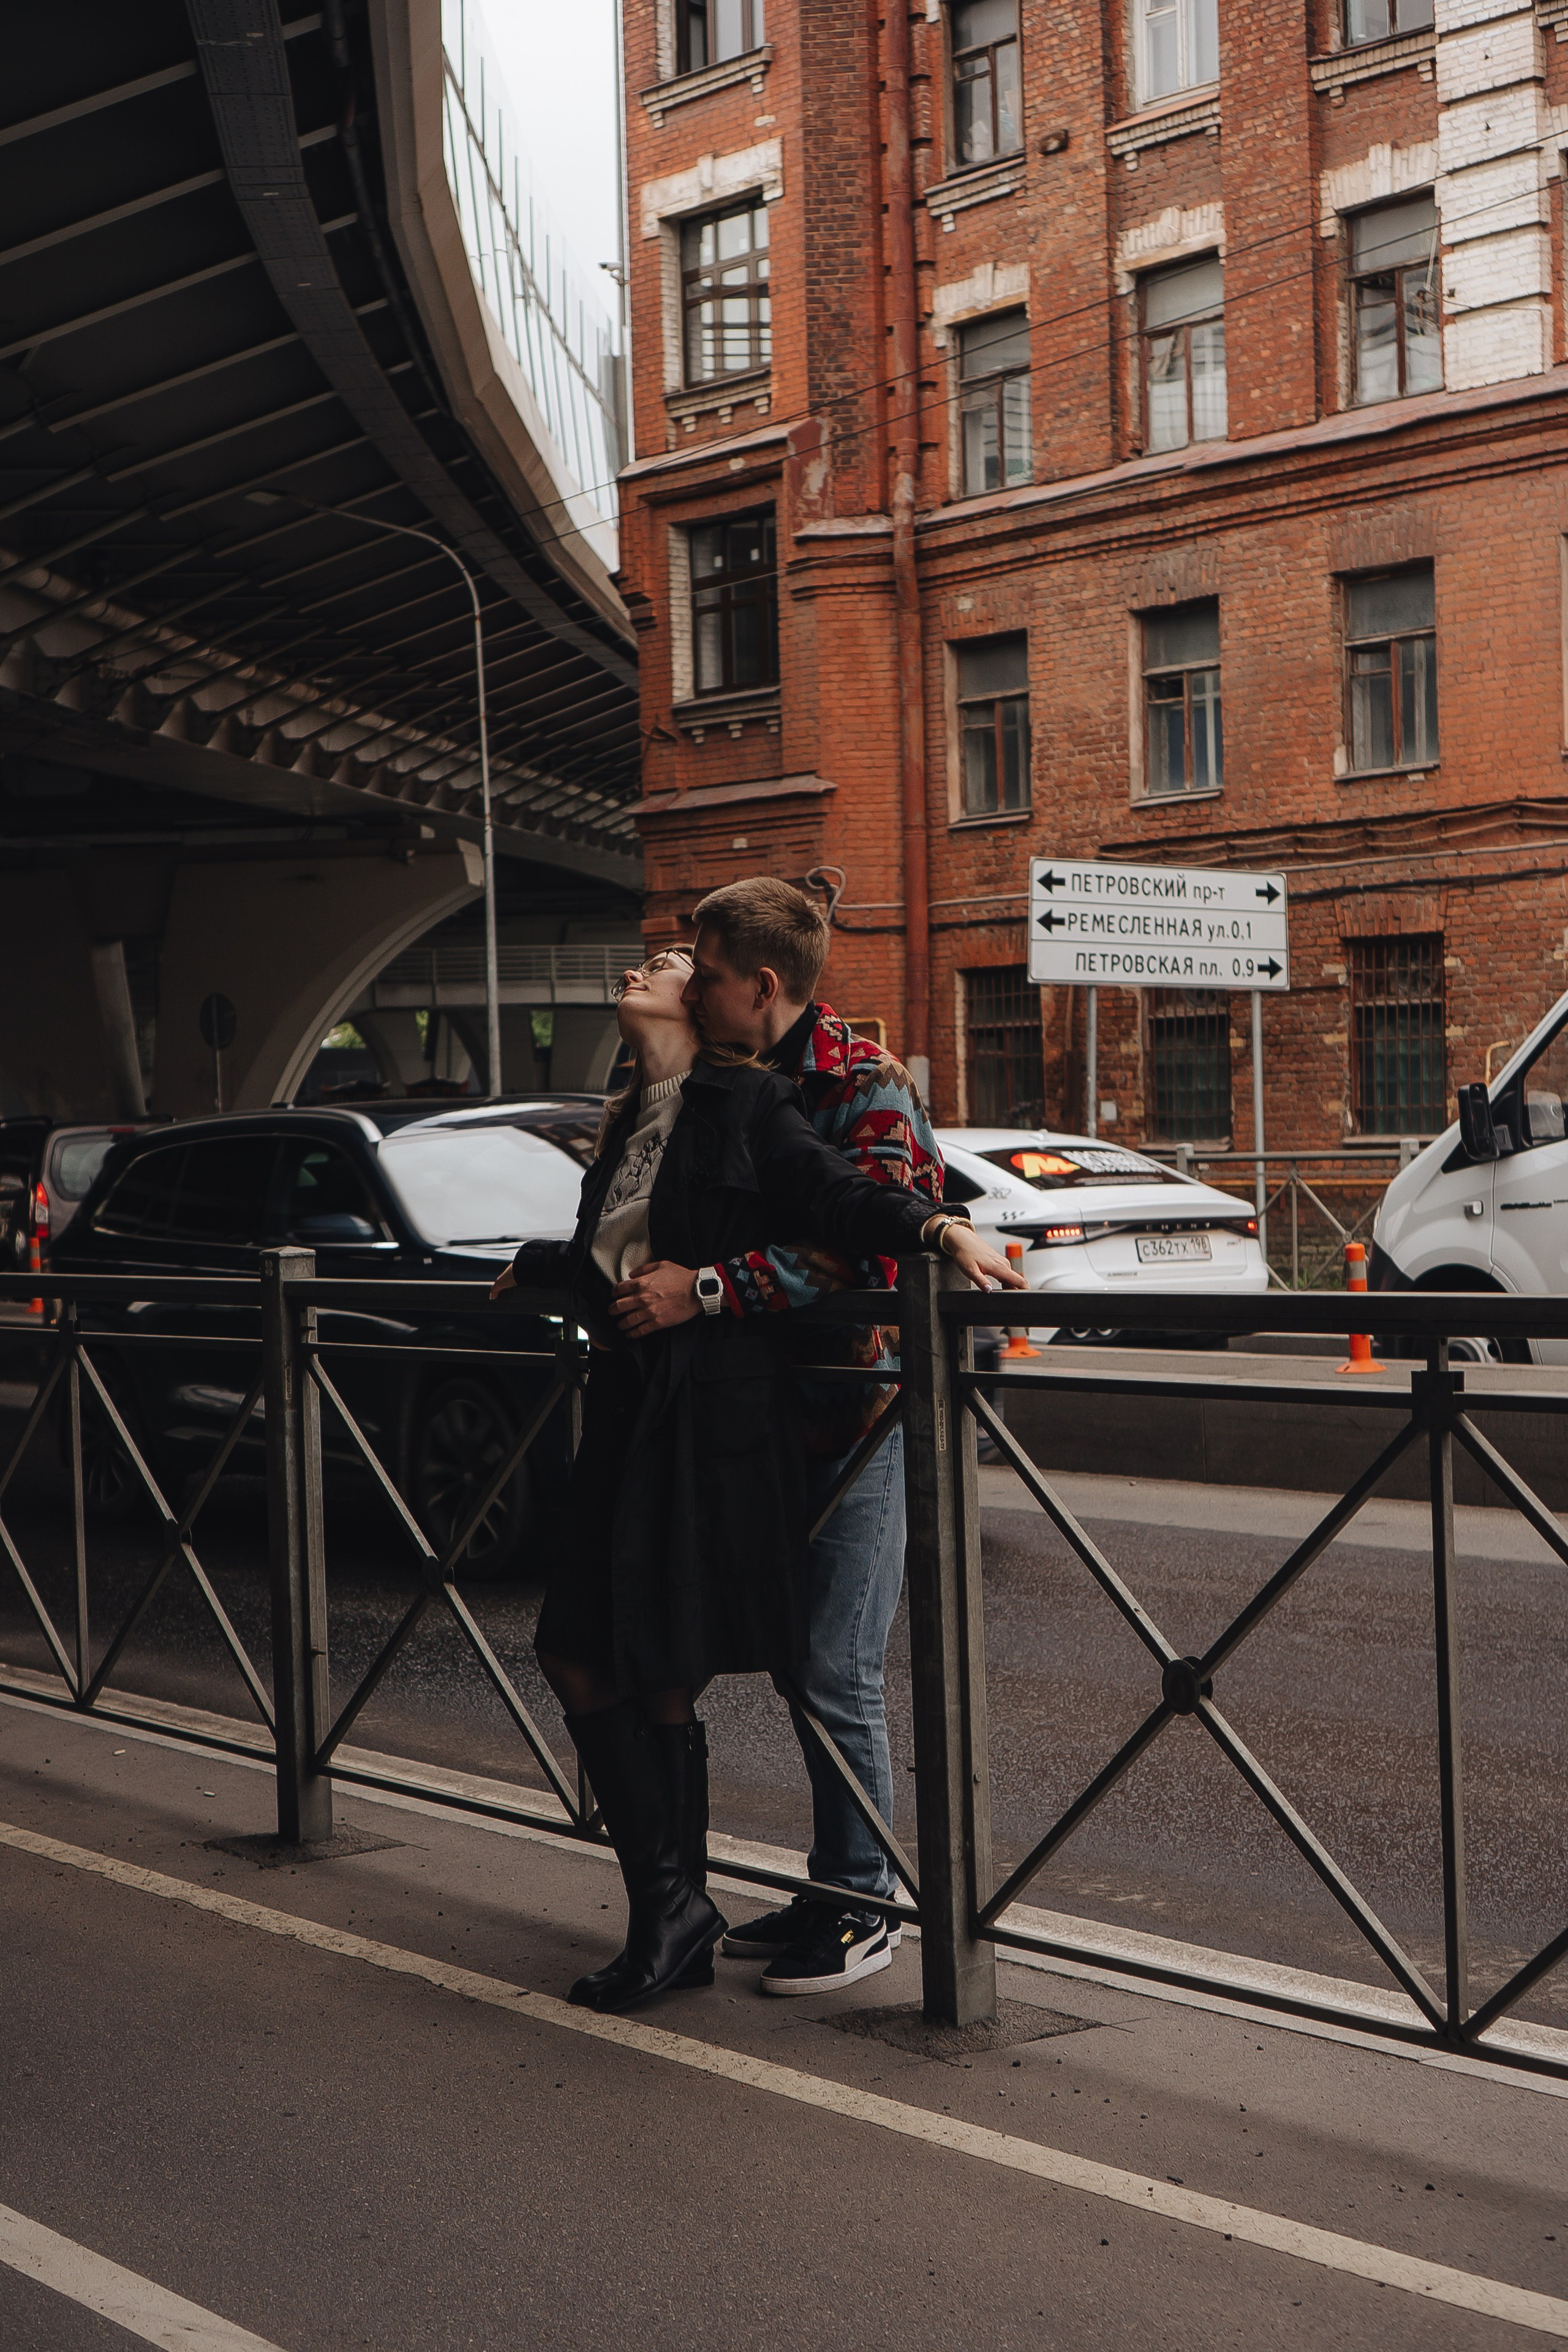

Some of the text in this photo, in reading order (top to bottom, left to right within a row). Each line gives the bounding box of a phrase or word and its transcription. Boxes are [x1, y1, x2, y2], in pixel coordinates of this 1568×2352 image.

[1072, 872, 1225, 905] ПЕТРОВСКИЙ пр-т
[1068, 911, 1202, 937] РЕМЕСЛЕННАЯ
[1076, 952, 1193, 975] ПЕТРОВСКАЯ
[1199, 962, 1223, 976] пл.
